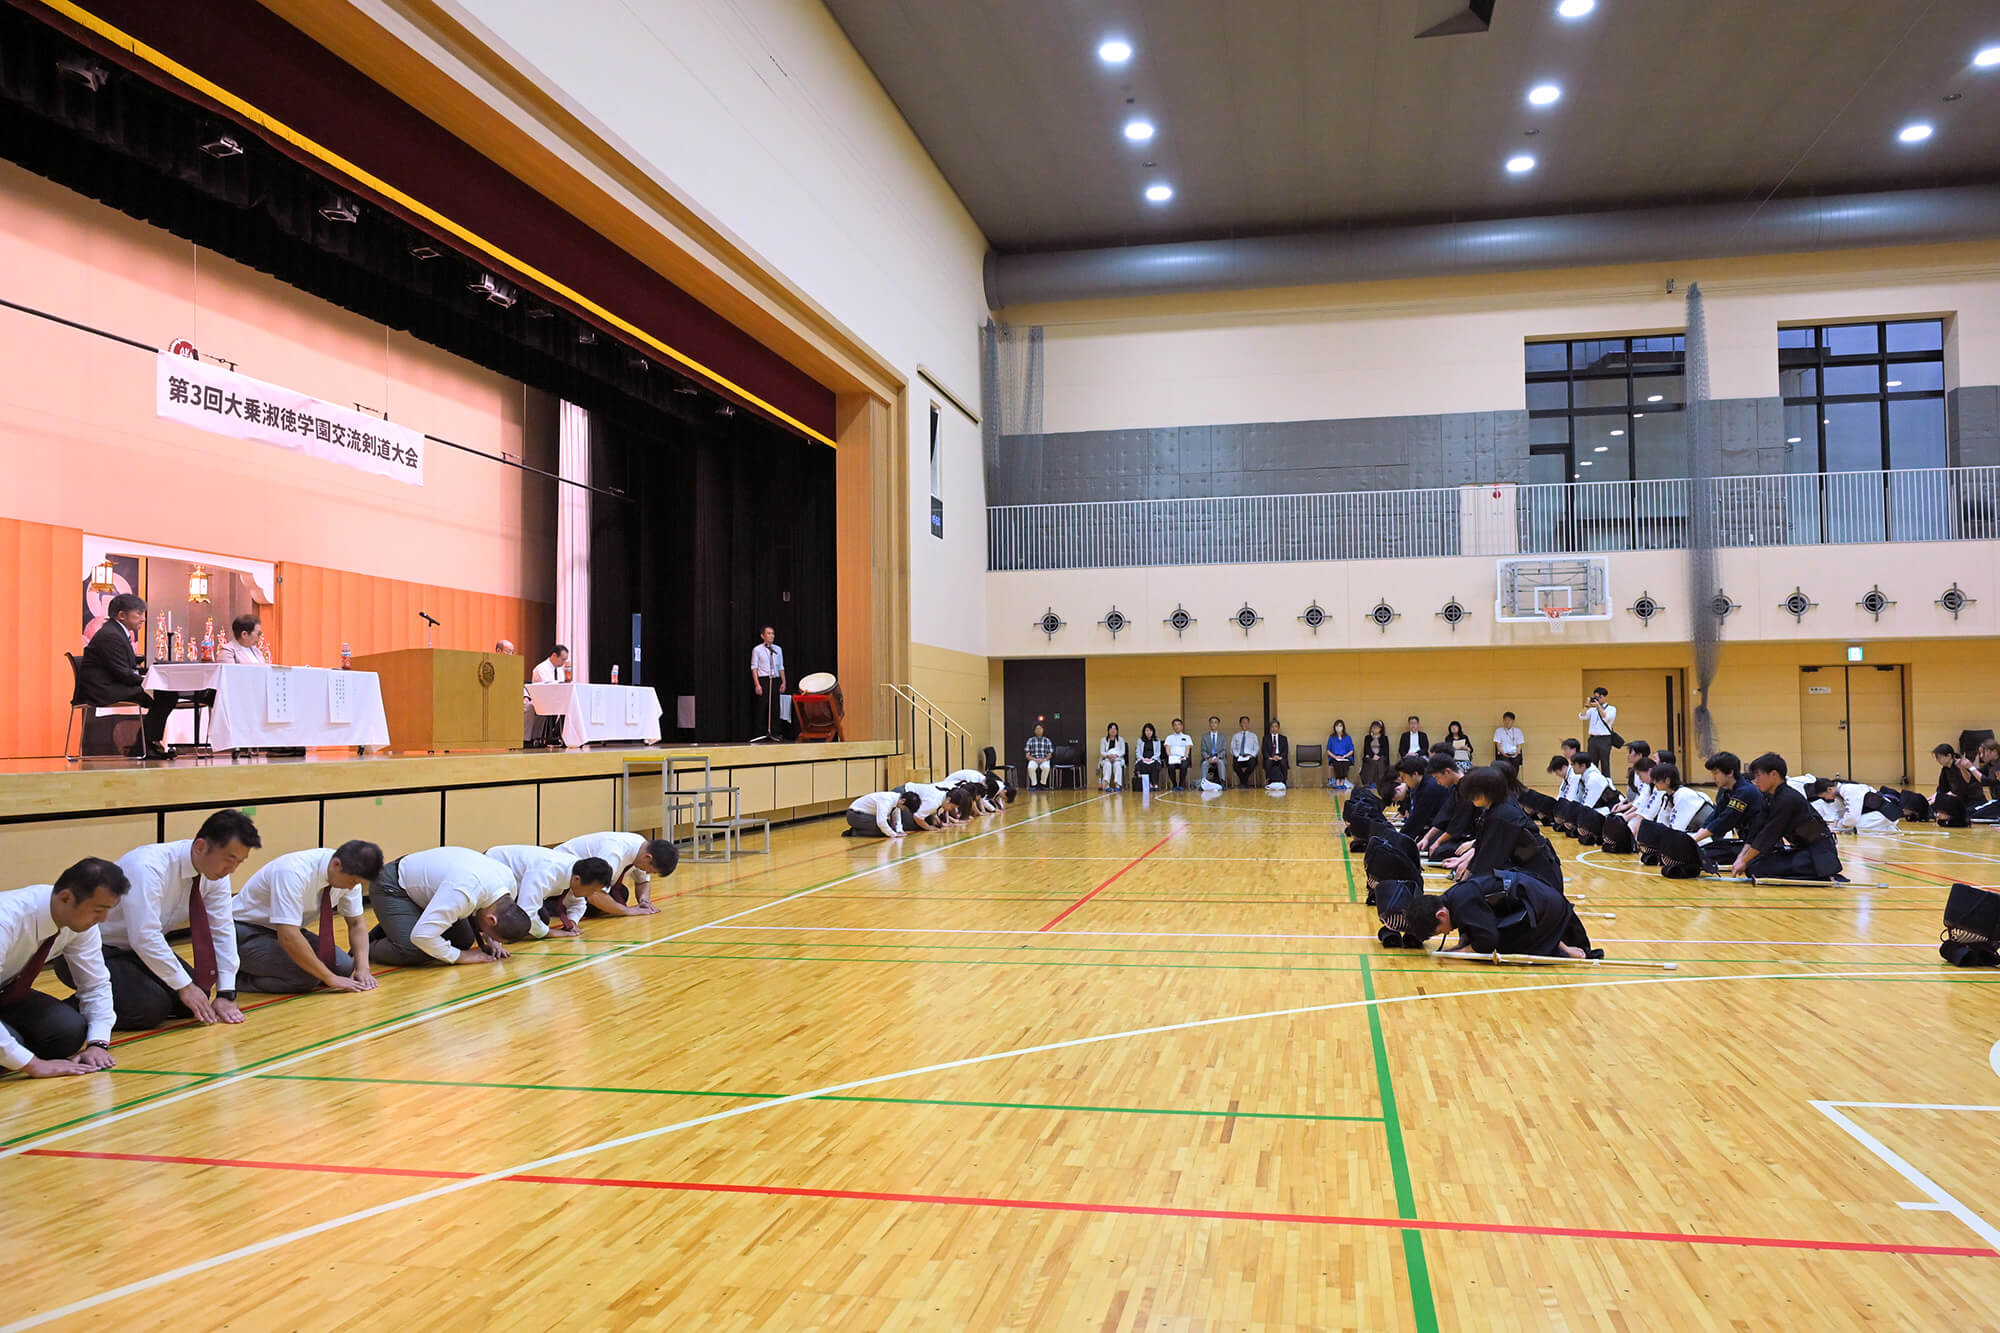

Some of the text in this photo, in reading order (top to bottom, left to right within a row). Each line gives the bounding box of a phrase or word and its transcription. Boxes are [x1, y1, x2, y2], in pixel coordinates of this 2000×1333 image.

[168, 375, 418, 469] 第3回大乗淑徳学園交流剣道大会
